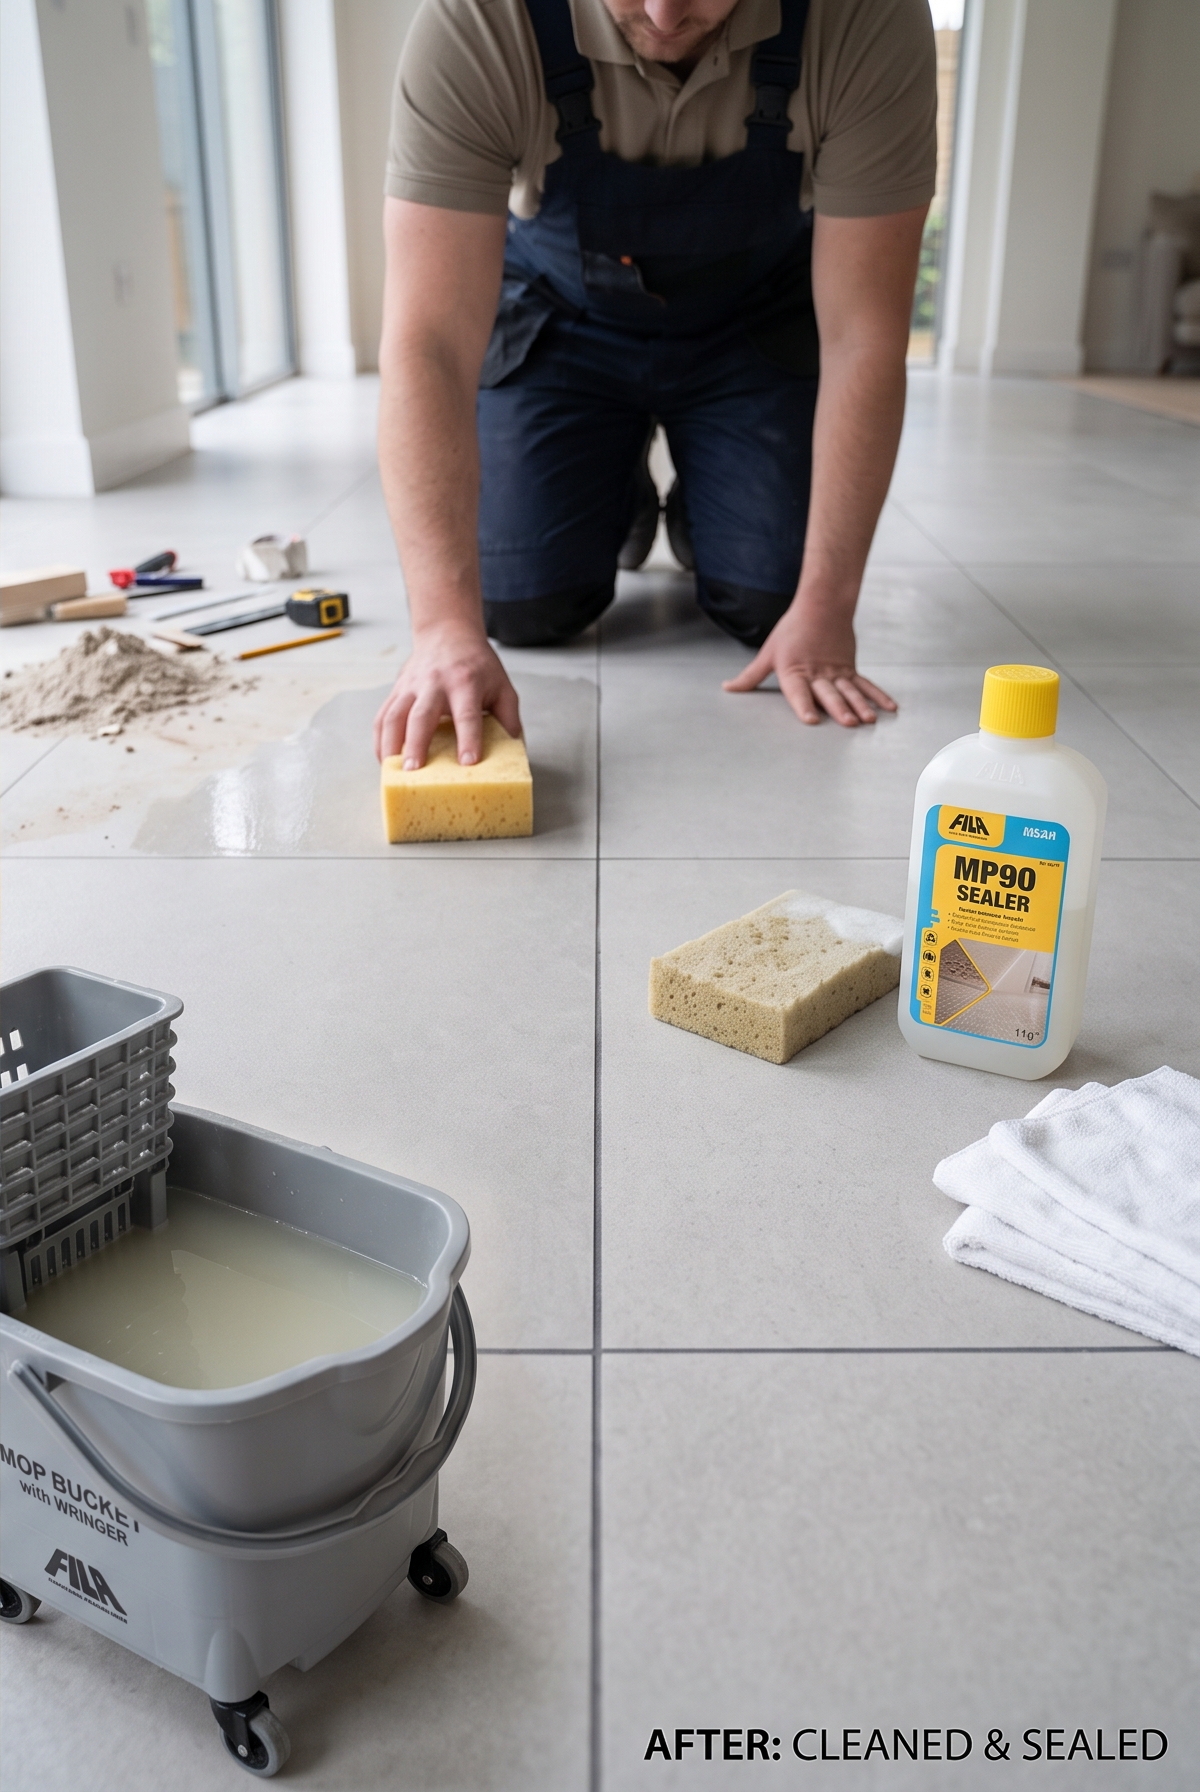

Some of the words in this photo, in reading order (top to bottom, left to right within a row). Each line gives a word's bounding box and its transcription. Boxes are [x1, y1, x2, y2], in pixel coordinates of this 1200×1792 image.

[948, 813, 990, 837] FILA
[953, 855, 1037, 892] MP90
[956, 884, 1031, 913] SEALER
[0, 1443, 46, 1481] MOP
[19, 1480, 51, 1506] with
[54, 1496, 129, 1547] WRINGER
[44, 1548, 128, 1616] FILA
